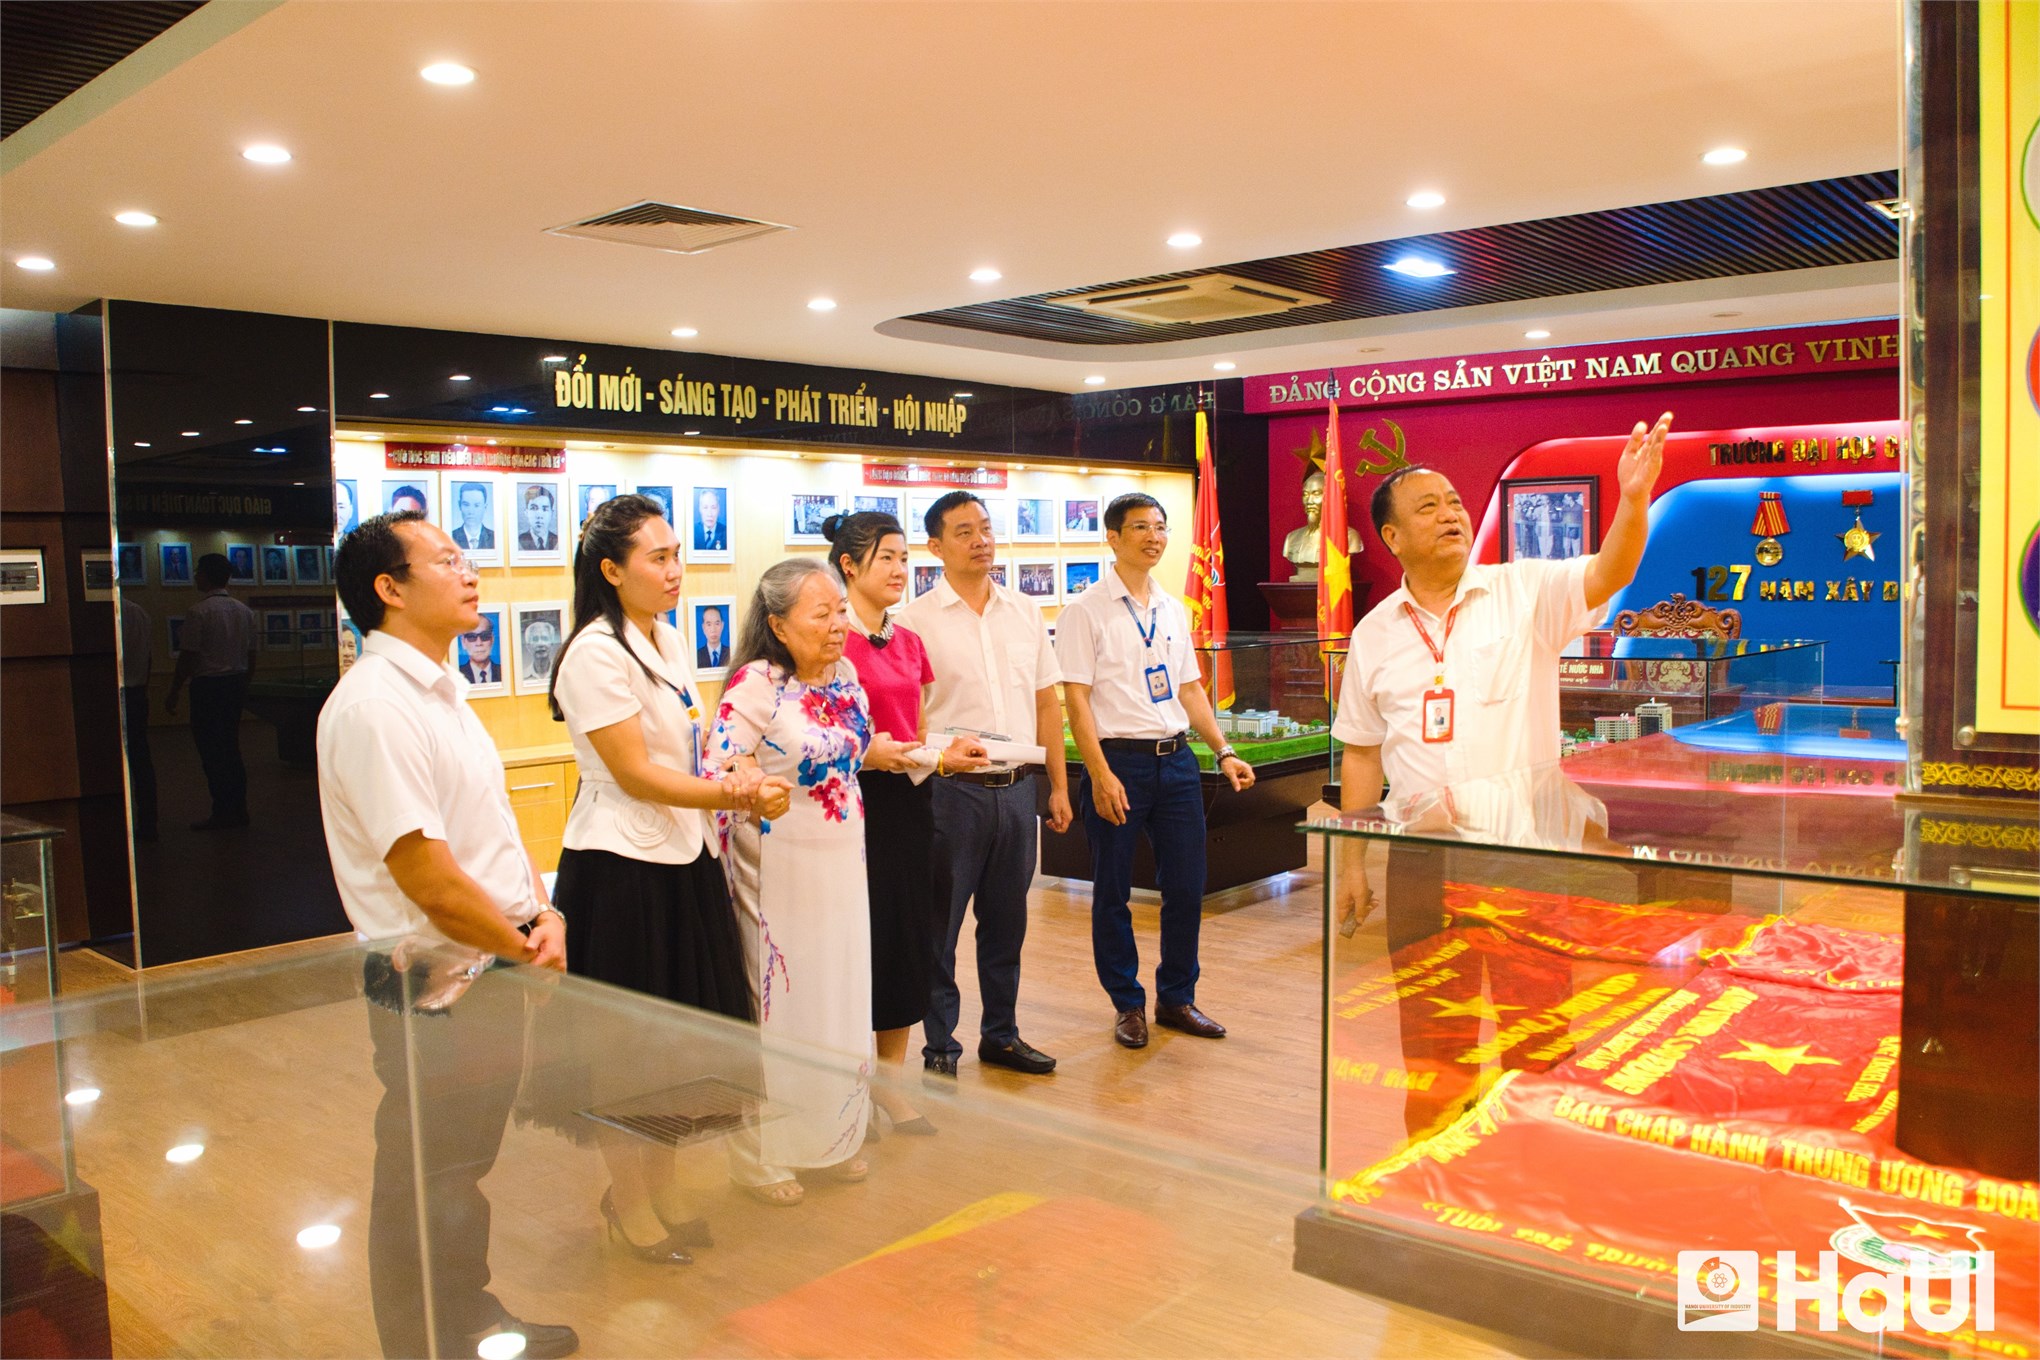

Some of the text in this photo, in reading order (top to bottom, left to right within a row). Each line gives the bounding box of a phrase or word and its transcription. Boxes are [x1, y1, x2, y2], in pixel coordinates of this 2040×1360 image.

[555, 354, 593, 409] ĐỔI
[600, 367, 642, 412] MỚI
[659, 373, 716, 416] SÁNG
[721, 384, 757, 424] TẠO
[775, 384, 820, 423] PHÁT
[828, 382, 878, 427] TRIỂN
[894, 394, 920, 436] HỘI
[925, 398, 967, 438] NHẬP
[1269, 334, 1899, 404] ĐẢNG CỘNG SẢN VIỆT NAM QUANG VINH
[1709, 437, 1785, 465] TRƯỜNG
[1792, 438, 1828, 466] ĐẠI
[1836, 435, 1877, 464] HỌC
[1691, 565, 1752, 601] 127
[1760, 578, 1815, 601] NĂM
[1826, 576, 1874, 601] XÂY
[1553, 1095, 1612, 1129] BAN
[1690, 1122, 1769, 1165] HÀNH
[1781, 1139, 1870, 1189] TRUNG
[1880, 1159, 1964, 1208] ƯƠNG
